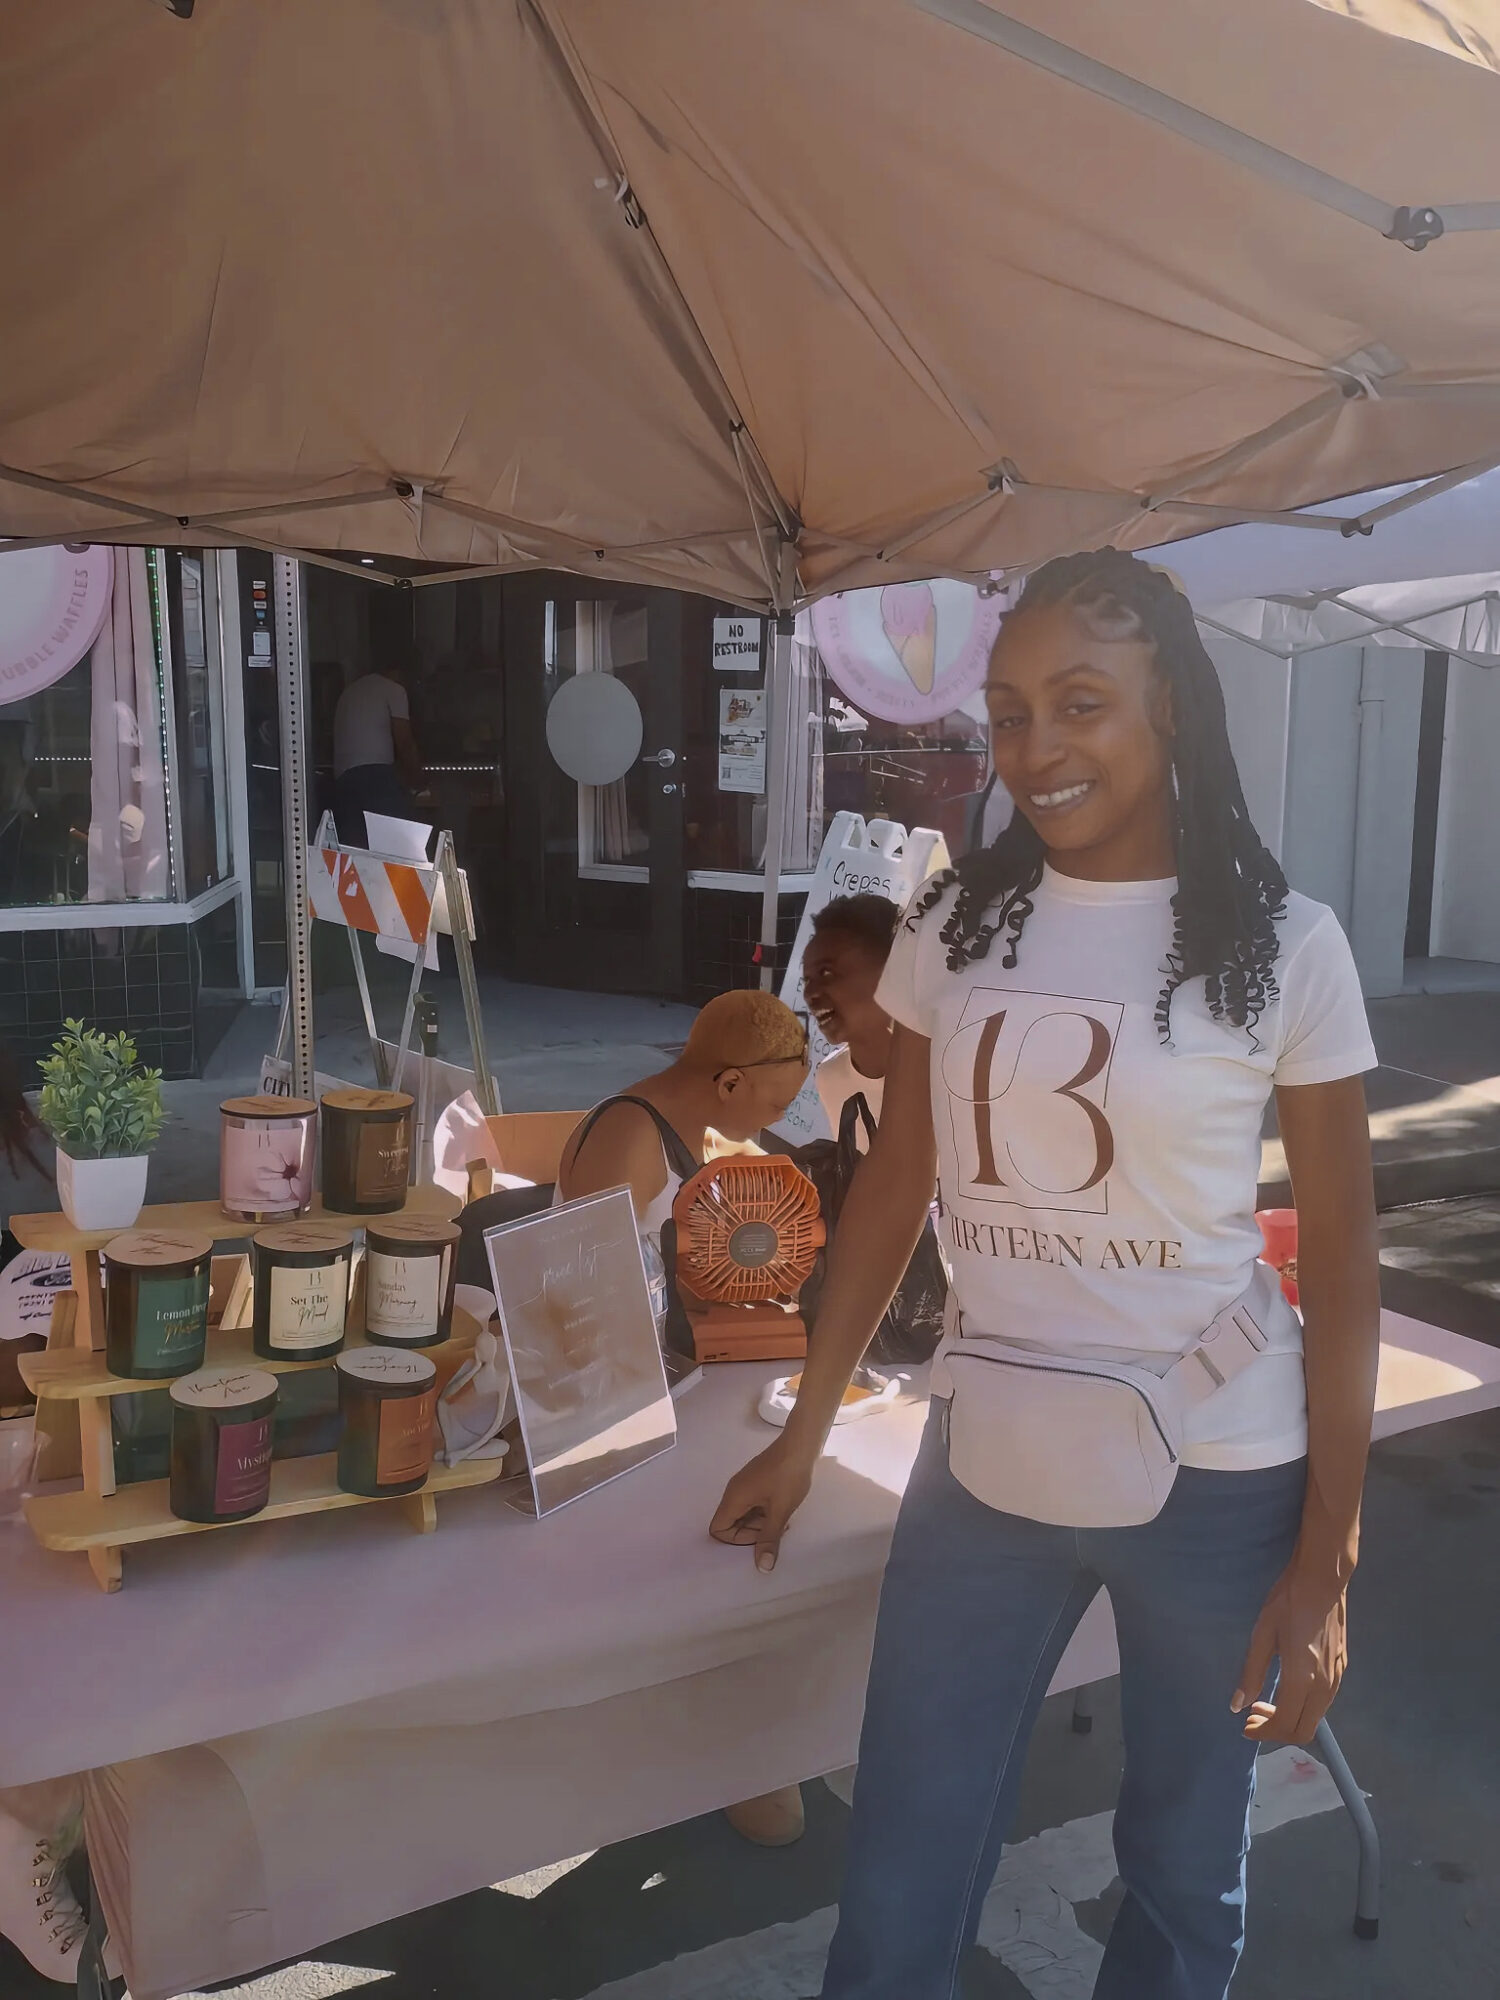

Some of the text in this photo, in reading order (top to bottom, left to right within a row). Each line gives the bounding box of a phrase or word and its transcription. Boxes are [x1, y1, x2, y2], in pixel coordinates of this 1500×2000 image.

[0, 567, 89, 685] UBBLE WAFFLES
[728, 624, 744, 637] NO
[714, 641, 759, 657] RESTROOM
[833, 860, 891, 898] Crepes
[941, 1009, 1115, 1194] 13
[1099, 1238, 1182, 1270] AVE
[311, 1293, 329, 1305] The
[156, 1308, 192, 1321] Lemon
